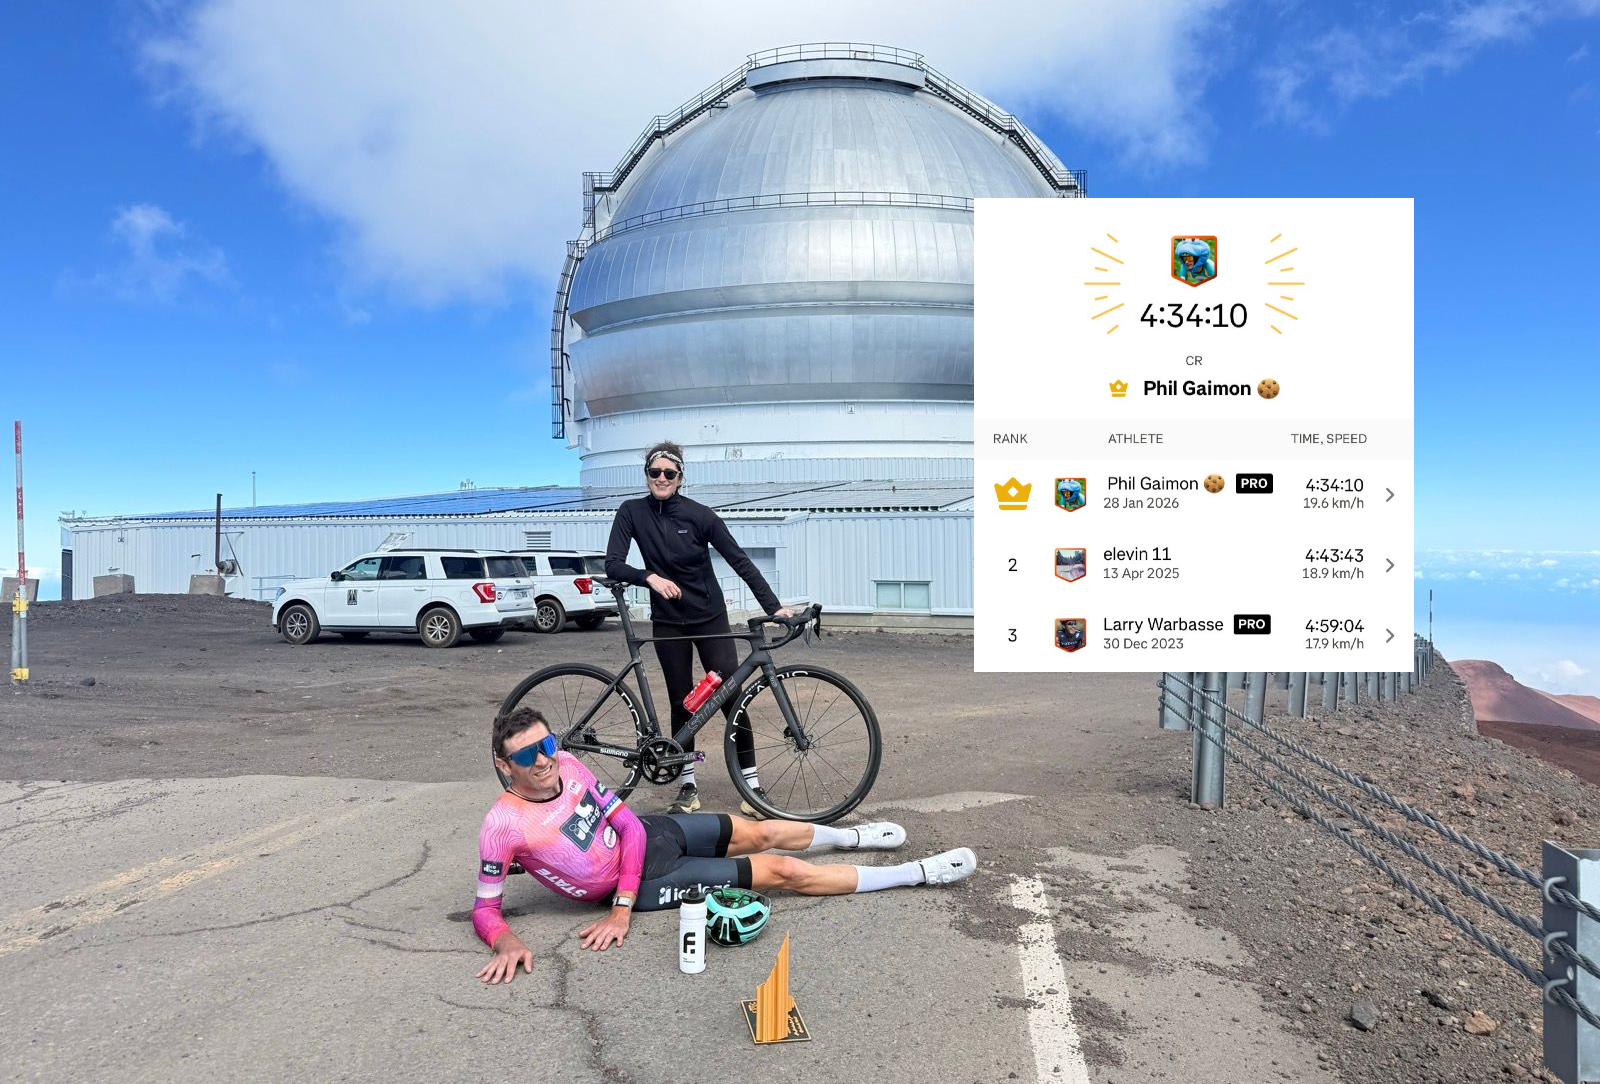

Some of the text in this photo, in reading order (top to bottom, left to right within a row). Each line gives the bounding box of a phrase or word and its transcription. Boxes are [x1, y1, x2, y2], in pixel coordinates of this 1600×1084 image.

[687, 676, 738, 734] STATE
[599, 747, 629, 757] SHIMANO
[534, 867, 588, 898] STATE
